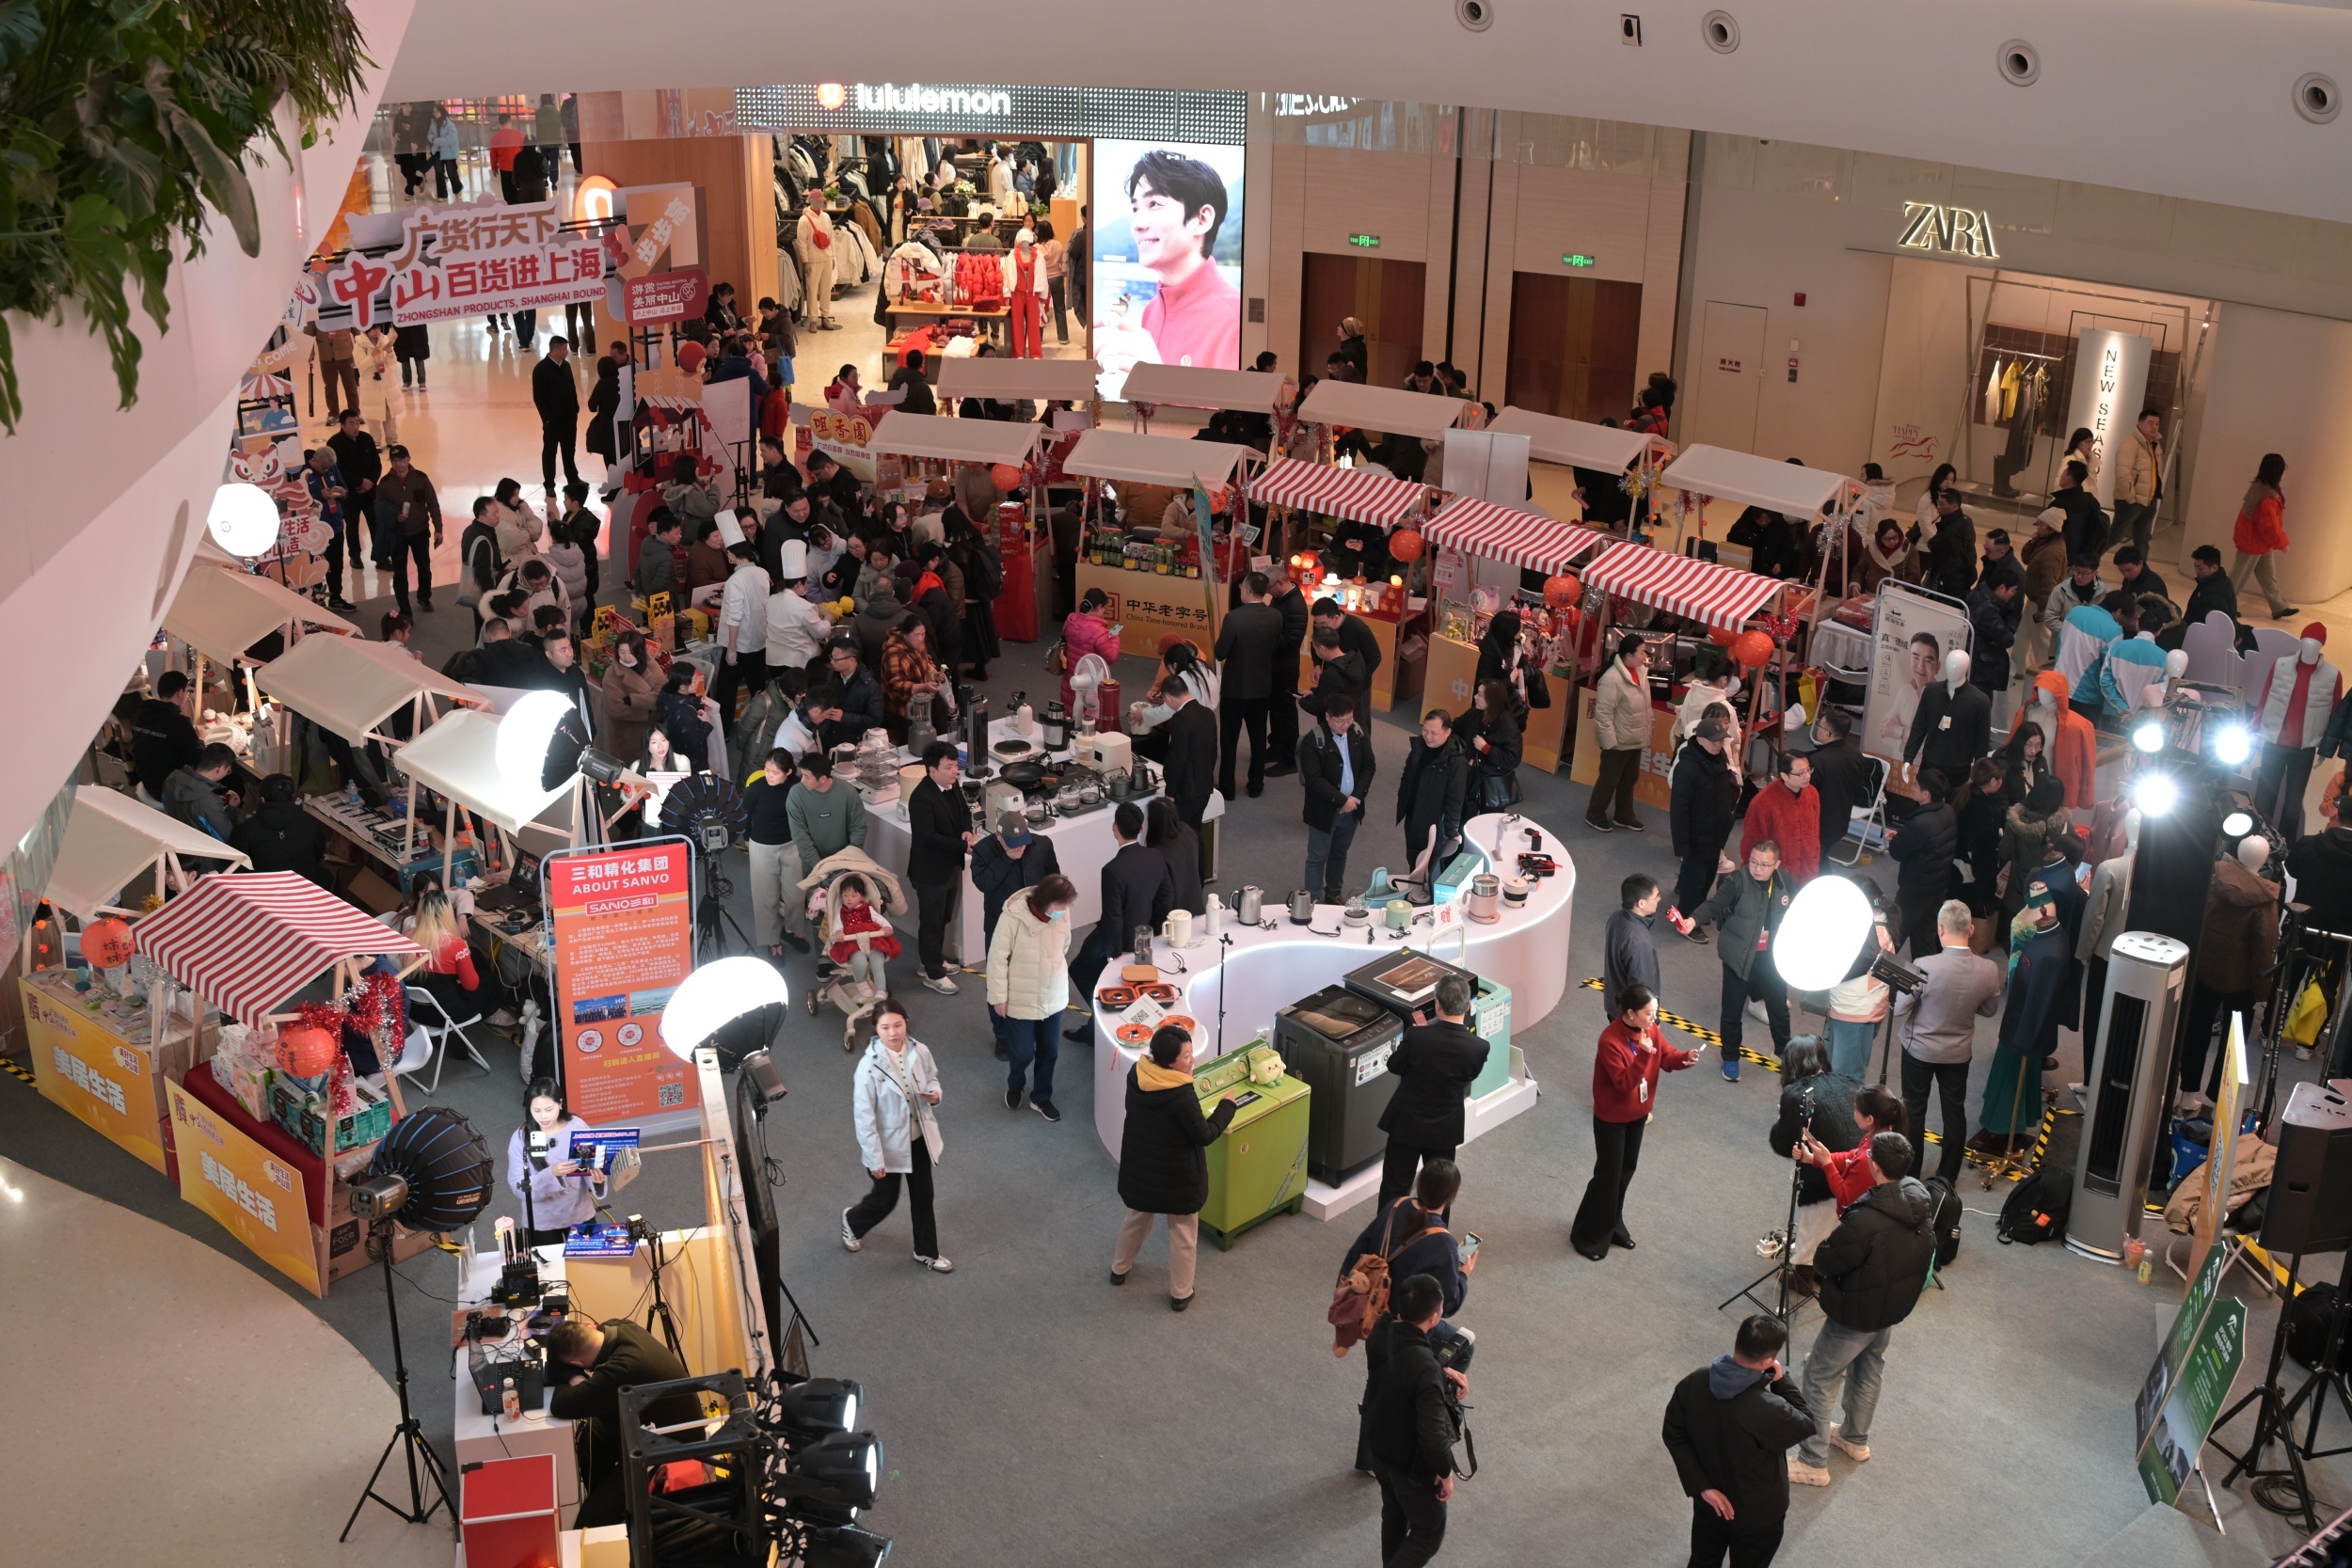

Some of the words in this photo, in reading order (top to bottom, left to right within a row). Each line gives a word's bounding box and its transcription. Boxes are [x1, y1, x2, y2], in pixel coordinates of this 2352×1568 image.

[857, 83, 1011, 115] lululemon
[390, 201, 557, 271] 广货行天下
[636, 196, 691, 266] 步步高
[1899, 201, 1999, 259] ZARA
[334, 247, 602, 327] 中山百货进上海
[632, 281, 656, 294] 游赏
[632, 292, 680, 309] 美丽中山
[397, 307, 461, 323] ZHONGSHAN
[464, 297, 518, 314] PRODUCTS,
[521, 292, 572, 306] SHANGHAI
[573, 286, 607, 300] BOUND
[1720, 358, 1741, 368] 消火栓
[2100, 349, 2117, 393] NEW
[2091, 403, 2109, 476] SEAS
[1126, 599, 1208, 622] 中华老字号
[1126, 612, 1143, 623] China
[1189, 622, 1208, 631] Brand
[571, 855, 669, 880] 三和精化集团
[572, 879, 619, 895] ABOUT
[623, 873, 670, 888] SANVO
[119, 1047, 138, 1065] 美好生活
[53, 1044, 127, 1117] 美居生活
[269, 1161, 290, 1182] 美好生活
[199, 1150, 278, 1233] 美居生活
[332, 1232, 355, 1246] Face
